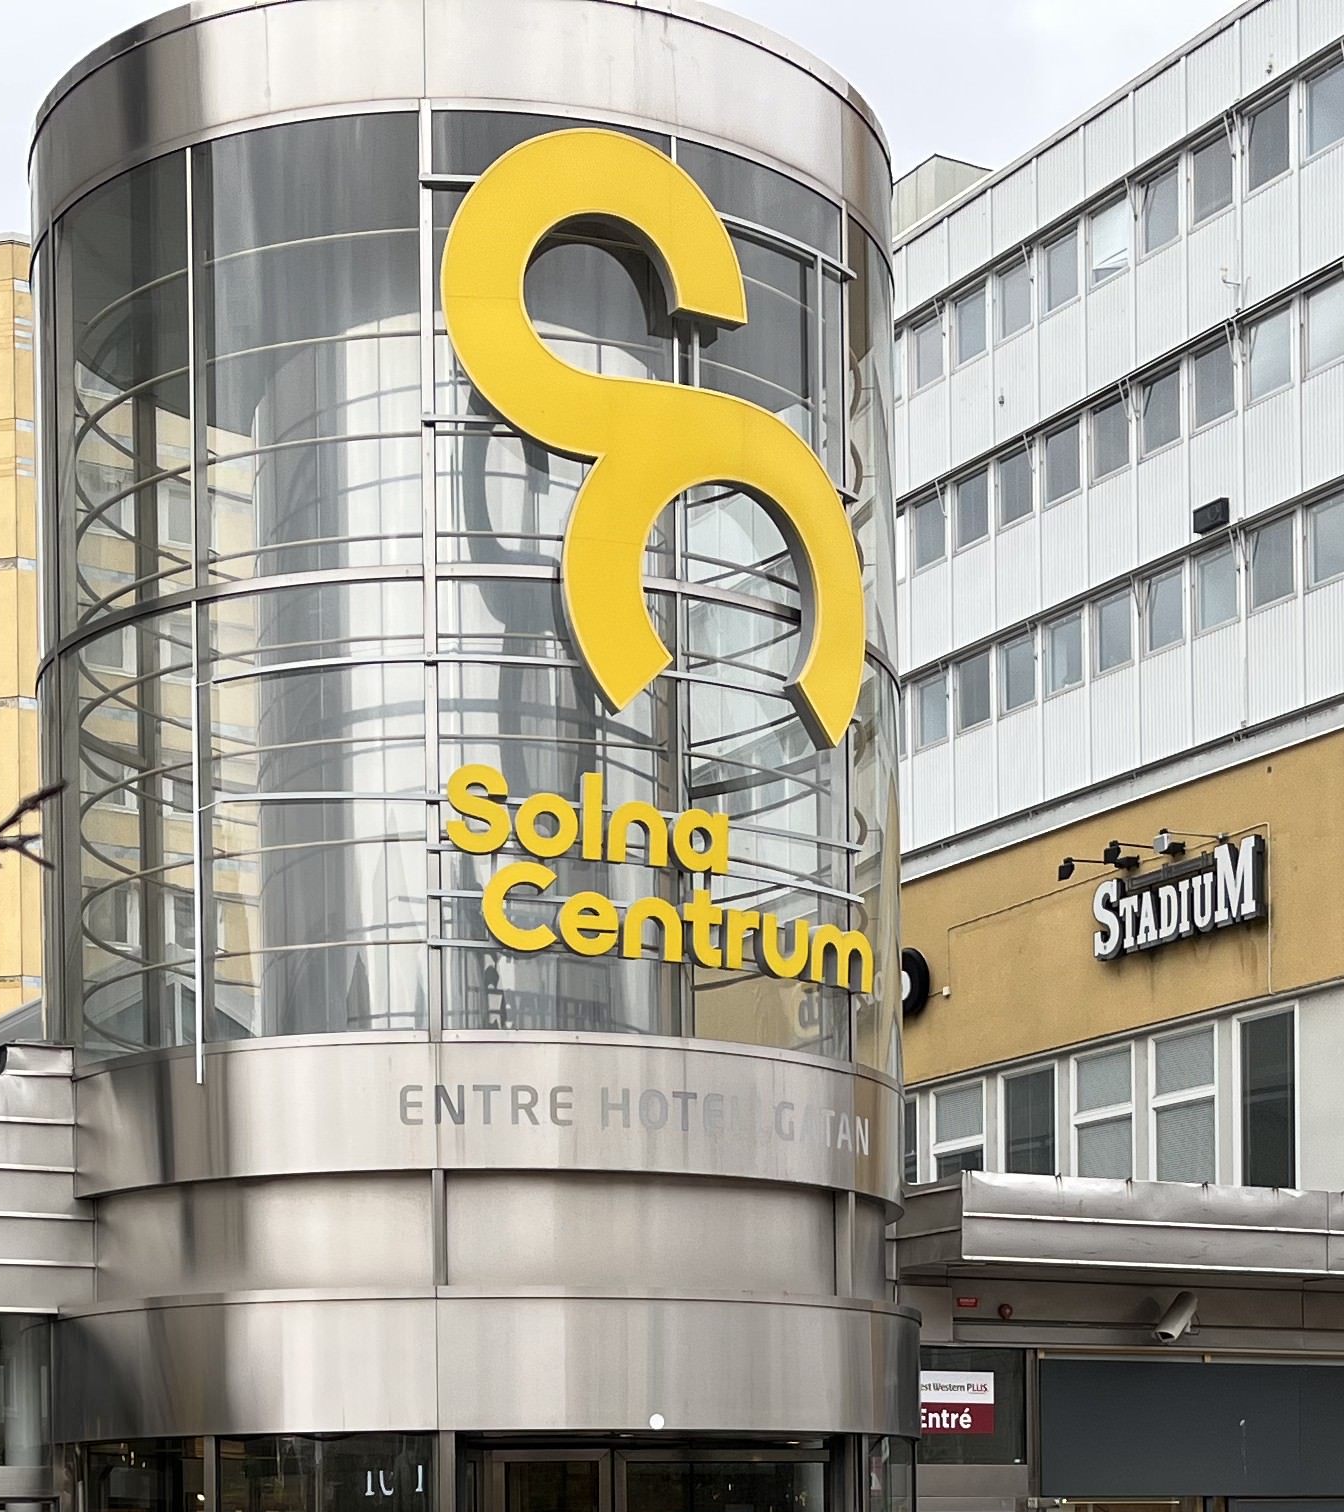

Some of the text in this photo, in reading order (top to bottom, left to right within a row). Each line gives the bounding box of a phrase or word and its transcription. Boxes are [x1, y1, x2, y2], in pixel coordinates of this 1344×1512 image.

[446, 763, 730, 875] Solna
[482, 861, 874, 993] Centrum
[1093, 834, 1262, 959] STADIUM
[399, 1084, 574, 1127] ENTRE
[921, 1382, 988, 1392] est Western PLUS
